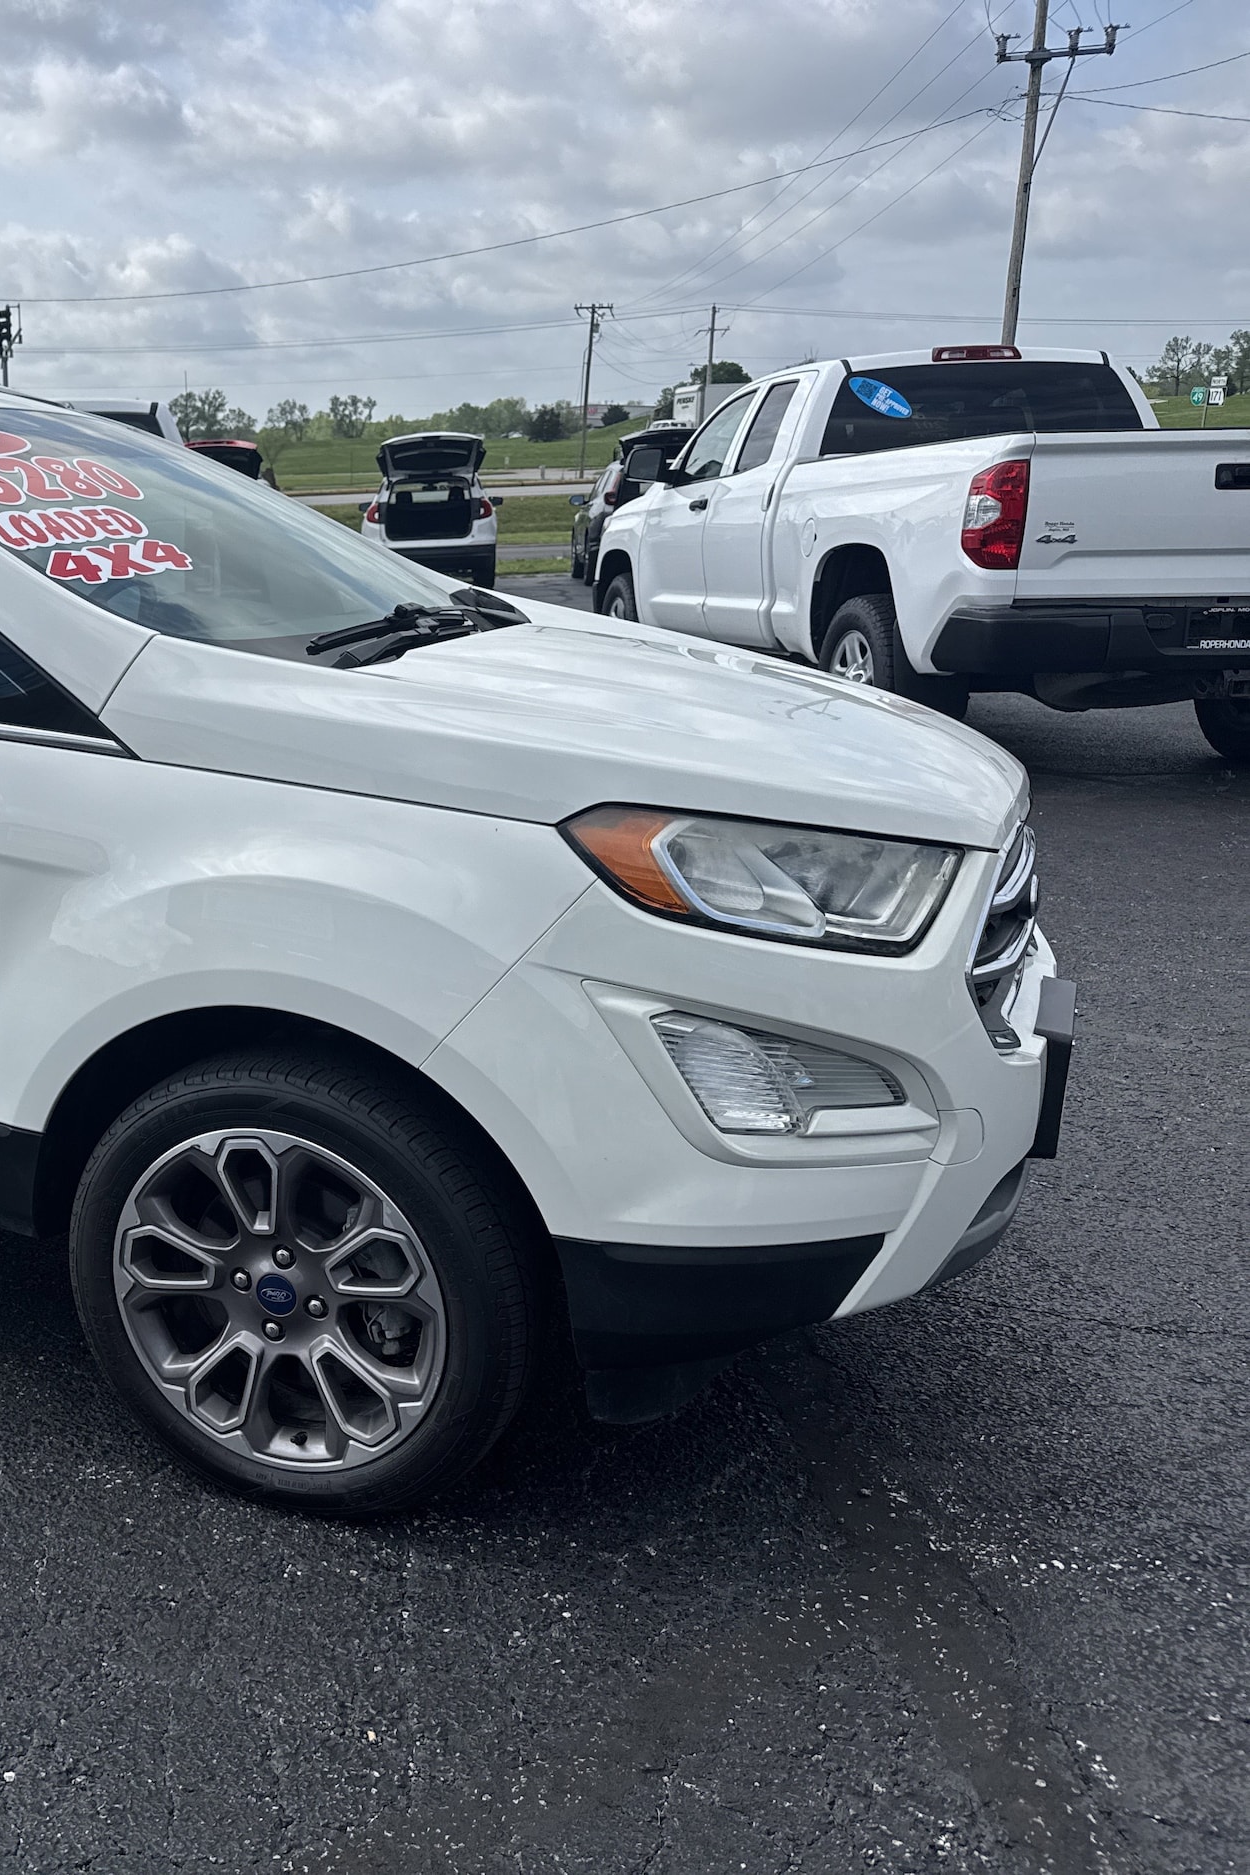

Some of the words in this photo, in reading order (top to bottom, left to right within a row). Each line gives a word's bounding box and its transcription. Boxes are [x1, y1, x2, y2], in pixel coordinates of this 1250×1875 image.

[879, 386, 893, 398] GET
[1192, 392, 1204, 402] 49
[1210, 390, 1222, 401] 171
[49, 540, 190, 582] 4X4
